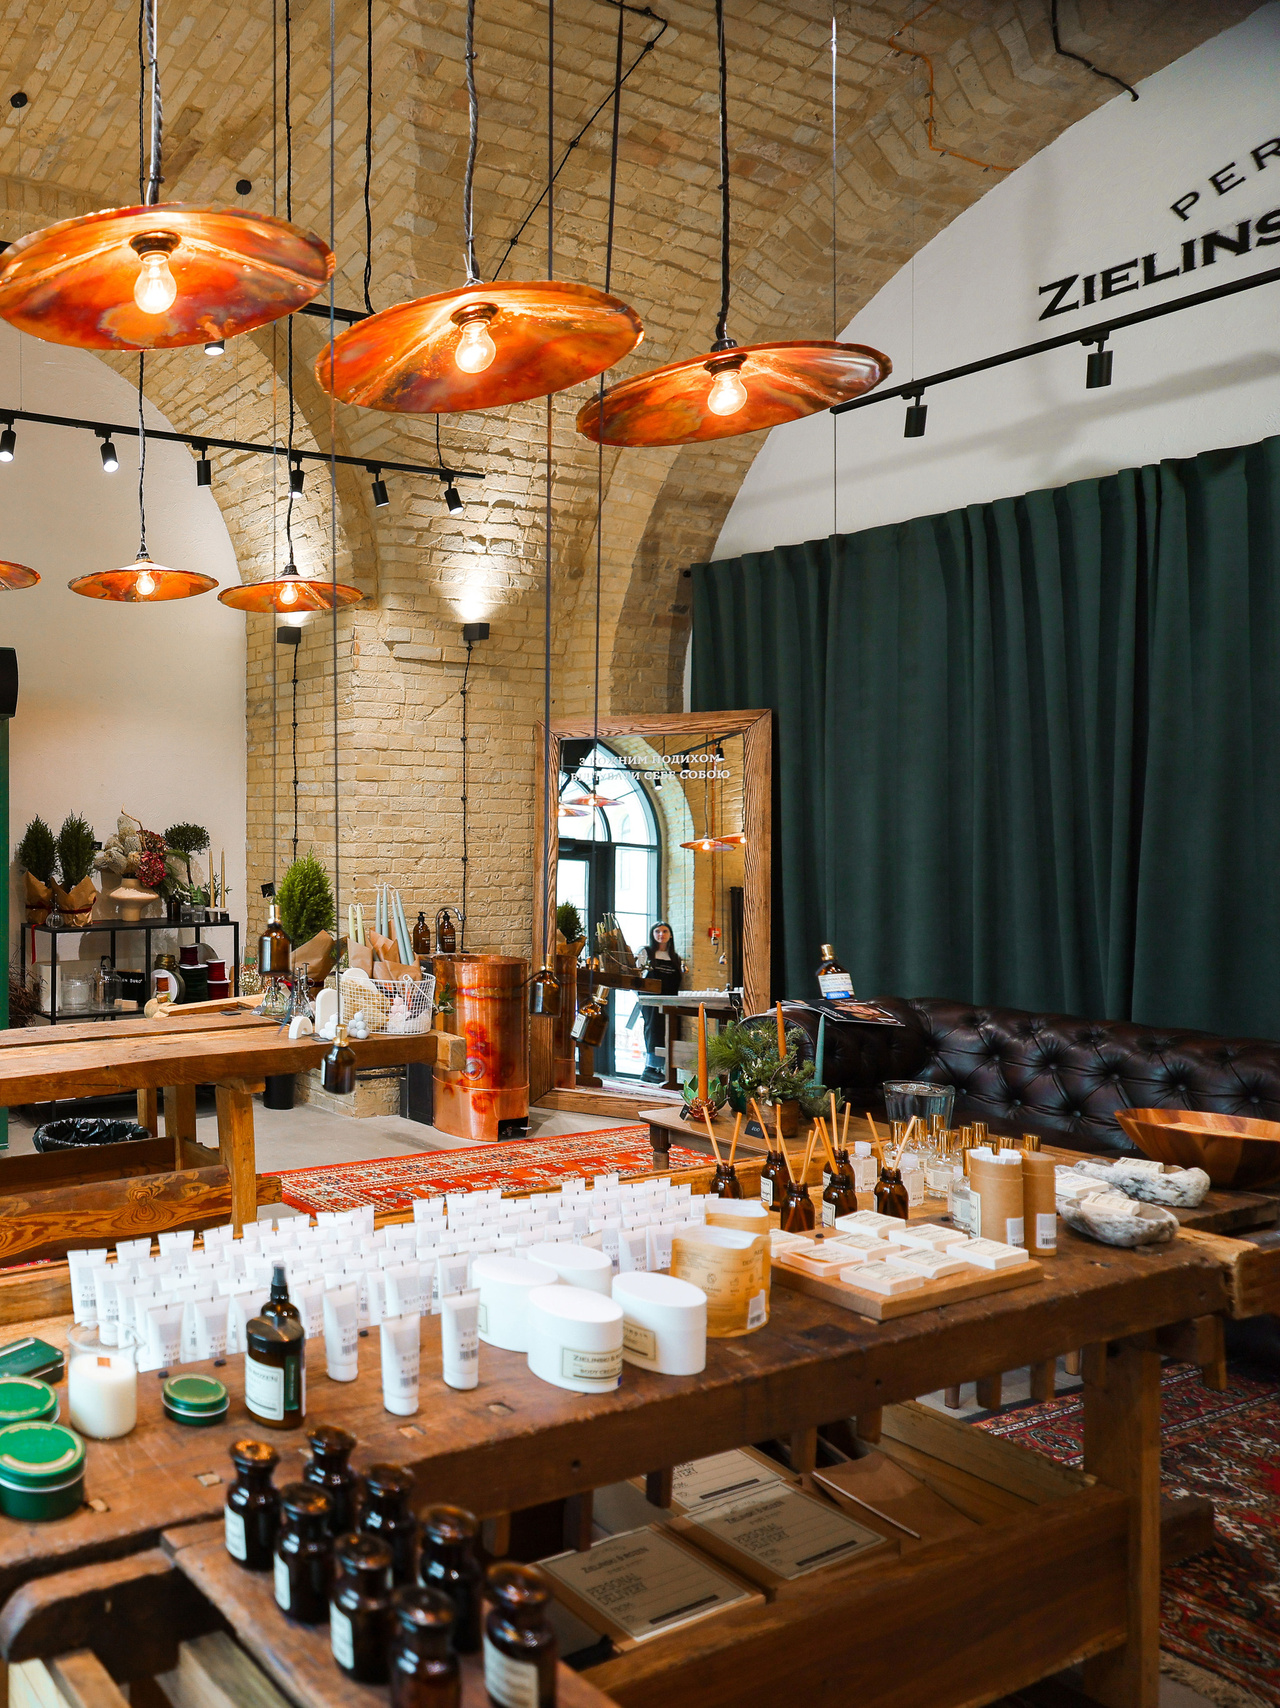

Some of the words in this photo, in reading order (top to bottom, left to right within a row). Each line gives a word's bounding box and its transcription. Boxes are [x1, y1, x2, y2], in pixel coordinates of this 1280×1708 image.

[1038, 207, 1280, 321] ZIELINS
[652, 754, 721, 765] ПОДИХОМ
[644, 771, 676, 780] СЕБЕ
[679, 769, 730, 780] СОБОЮ
